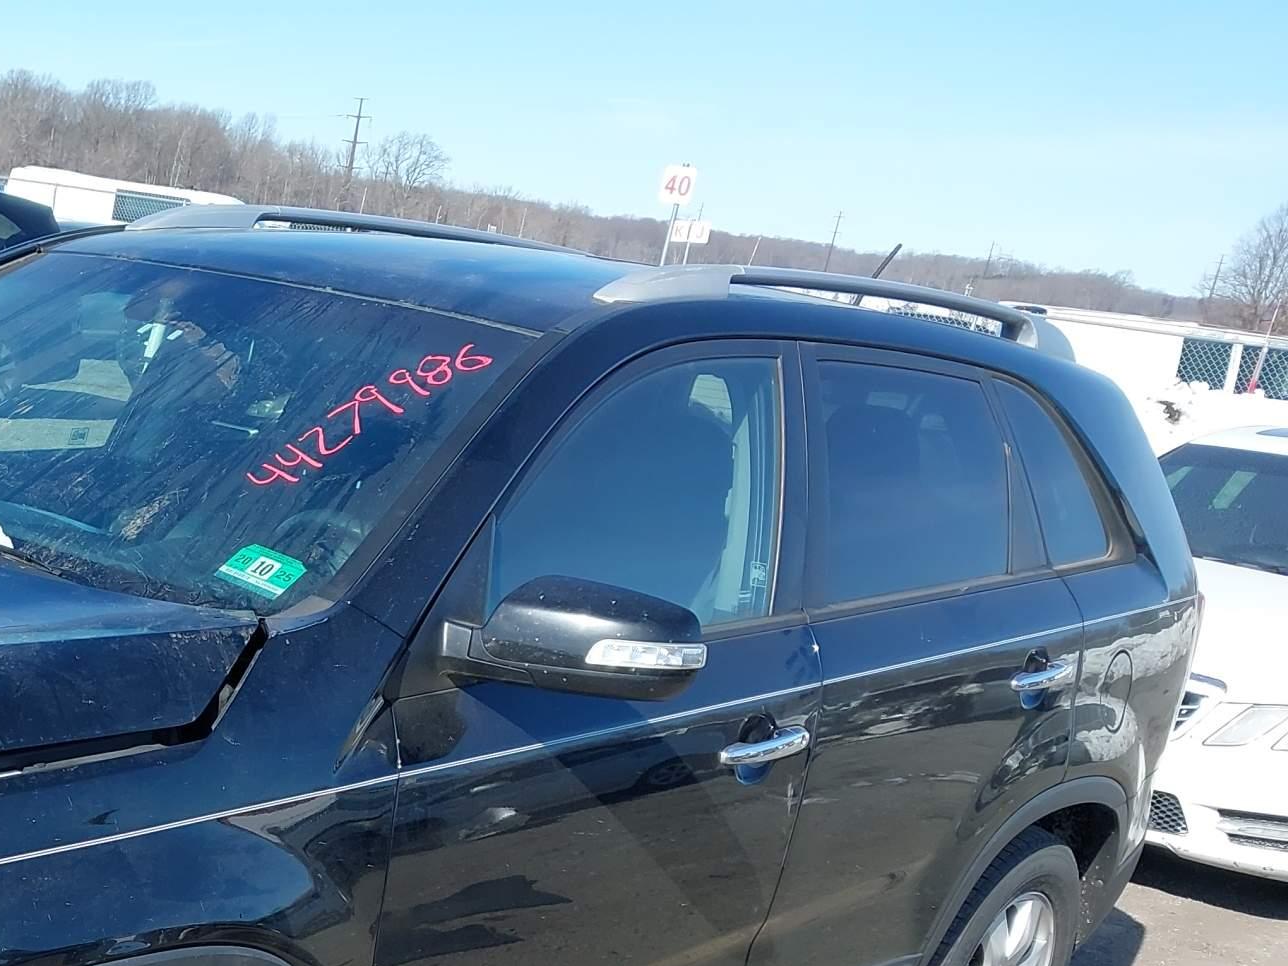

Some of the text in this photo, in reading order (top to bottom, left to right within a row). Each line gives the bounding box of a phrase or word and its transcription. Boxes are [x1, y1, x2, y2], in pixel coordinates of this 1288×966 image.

[664, 175, 691, 196] 40
[246, 343, 494, 485] 44279986
[235, 554, 253, 566] 20
[250, 560, 274, 577] 10
[274, 570, 295, 583] 25
